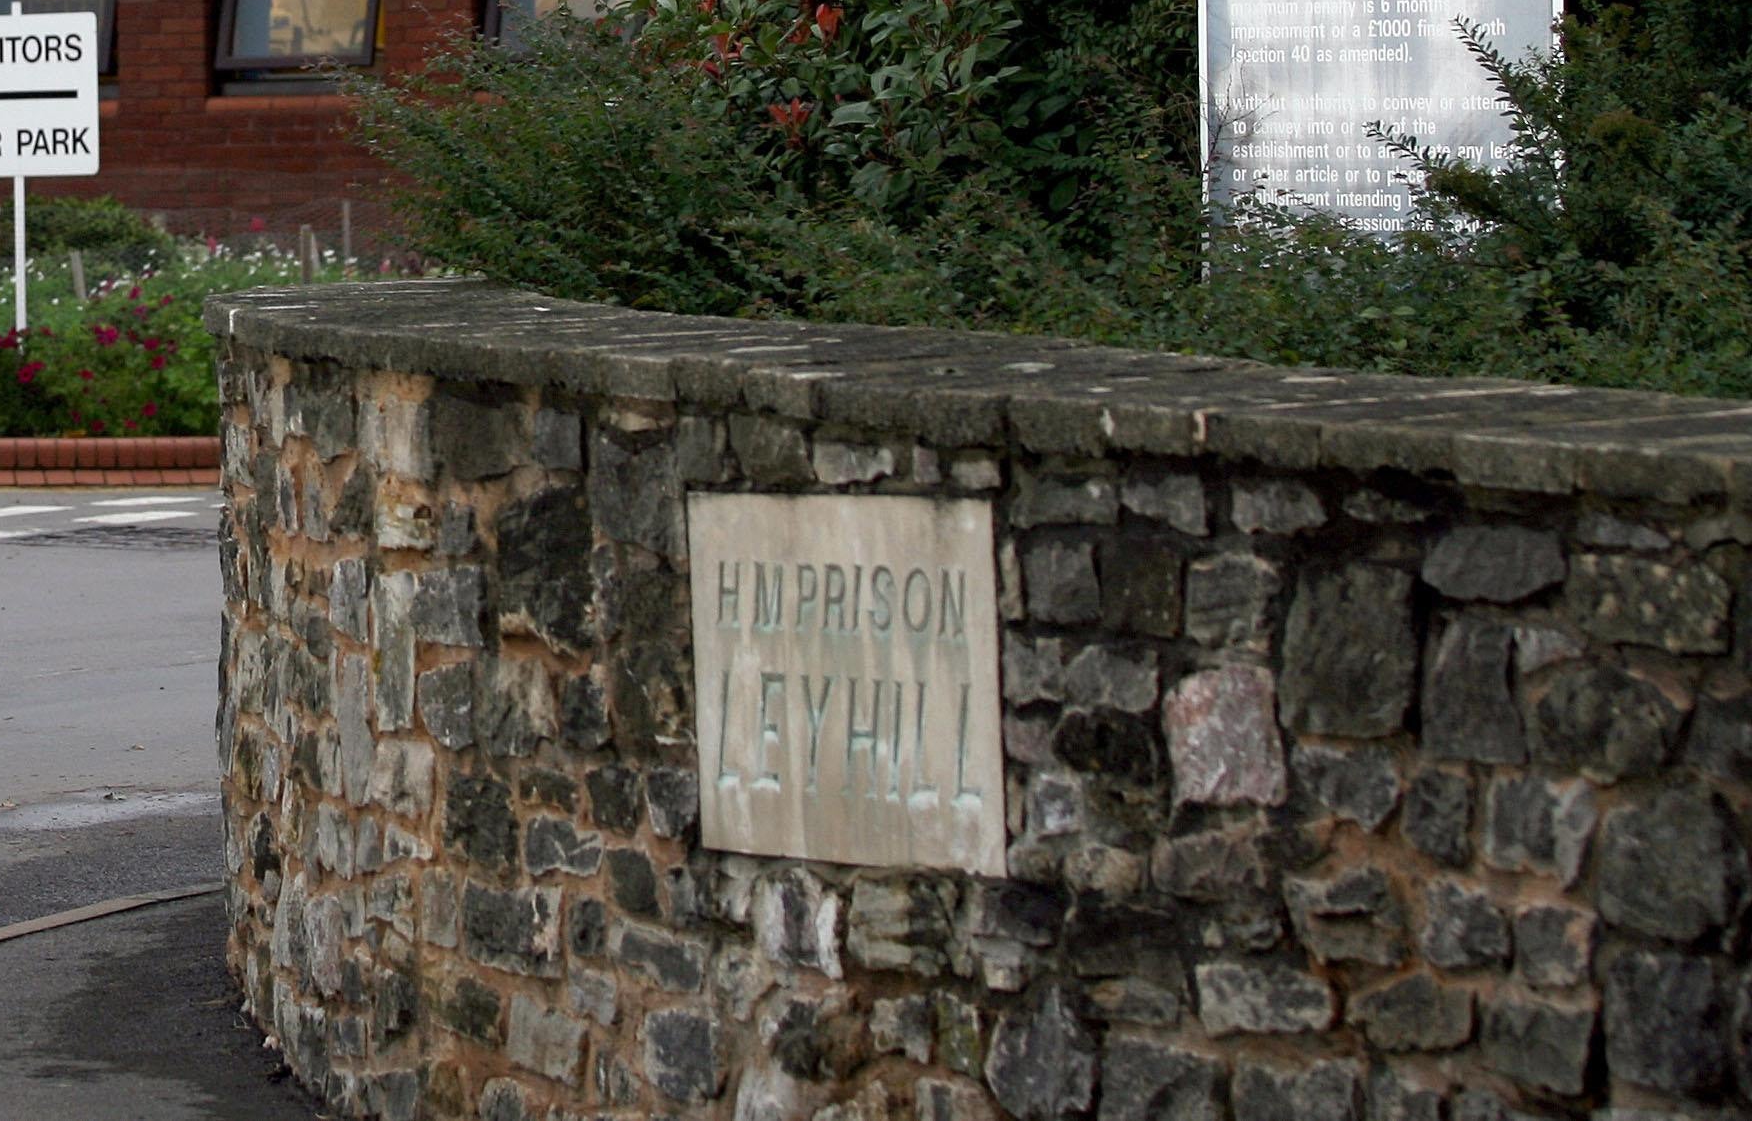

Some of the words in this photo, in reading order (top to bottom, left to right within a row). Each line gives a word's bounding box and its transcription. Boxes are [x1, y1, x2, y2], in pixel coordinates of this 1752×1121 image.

[1352, 25, 1361, 38] a
[1368, 19, 1411, 38] £1000
[1231, 43, 1285, 64] (section
[1291, 44, 1310, 62] 40
[1316, 48, 1333, 62] as
[1339, 42, 1413, 64] amended).
[1362, 95, 1377, 111] to
[1383, 96, 1433, 113] convey
[1439, 97, 1454, 110] or
[1232, 120, 1247, 135] to
[1307, 119, 1334, 135] into
[1341, 120, 1355, 134] or
[1412, 116, 1436, 135] the
[17, 127, 91, 156] PARK
[1232, 141, 1330, 159] establishment
[1335, 144, 1350, 159] or
[1356, 143, 1371, 159] to
[1457, 143, 1484, 163] any
[1232, 167, 1247, 182] or
[1295, 164, 1339, 182] article
[1345, 167, 1360, 182] or
[1366, 167, 1381, 183] to
[1336, 189, 1402, 211] intending
[717, 671, 983, 799] LEYHILL
